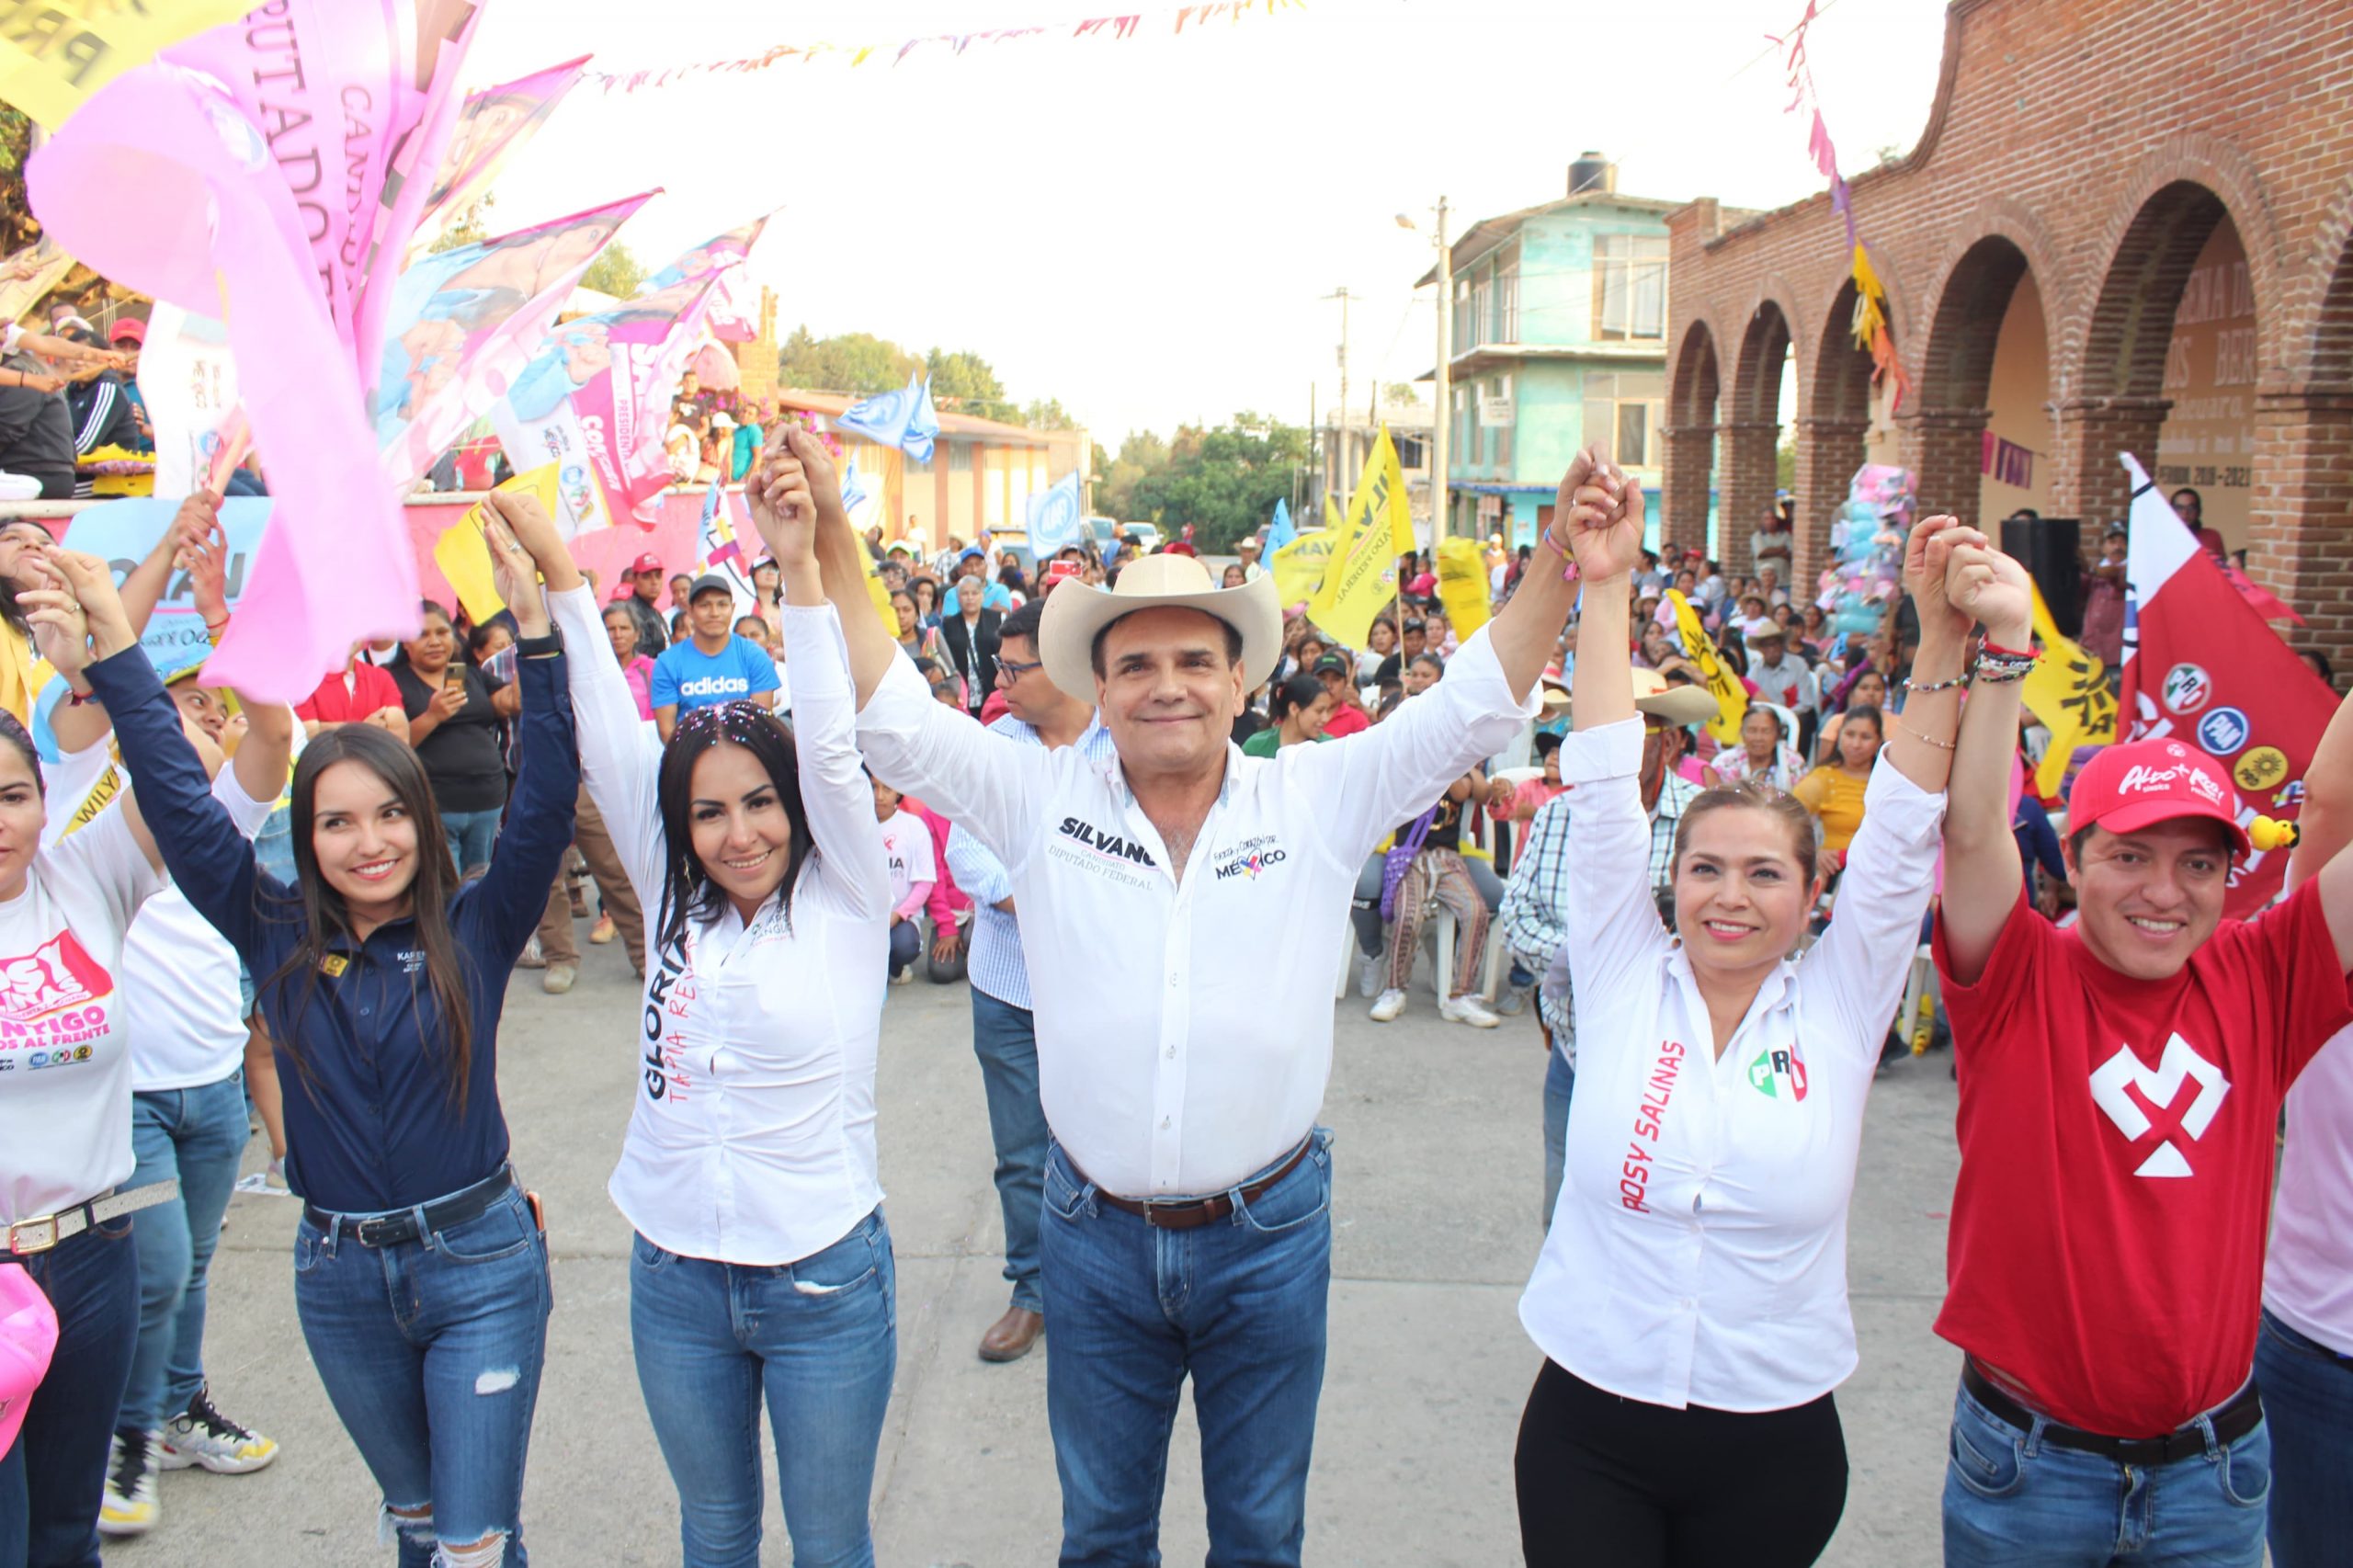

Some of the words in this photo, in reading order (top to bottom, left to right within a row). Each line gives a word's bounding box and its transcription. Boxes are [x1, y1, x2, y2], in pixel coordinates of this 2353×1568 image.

[681, 676, 748, 697] adidas
[2168, 669, 2204, 707] PRI
[2204, 713, 2243, 749] PAN
[1048, 844, 1102, 874] DIPUTADO
[1102, 869, 1154, 892] FEDERAL
[24, 1036, 47, 1050] AL
[51, 1023, 110, 1046] FRENTE
[645, 930, 690, 1100] GLORIA
[1634, 1040, 1686, 1142] SALINAS
[1749, 1048, 1807, 1093] PRI
[1620, 1142, 1654, 1214] ROSY
